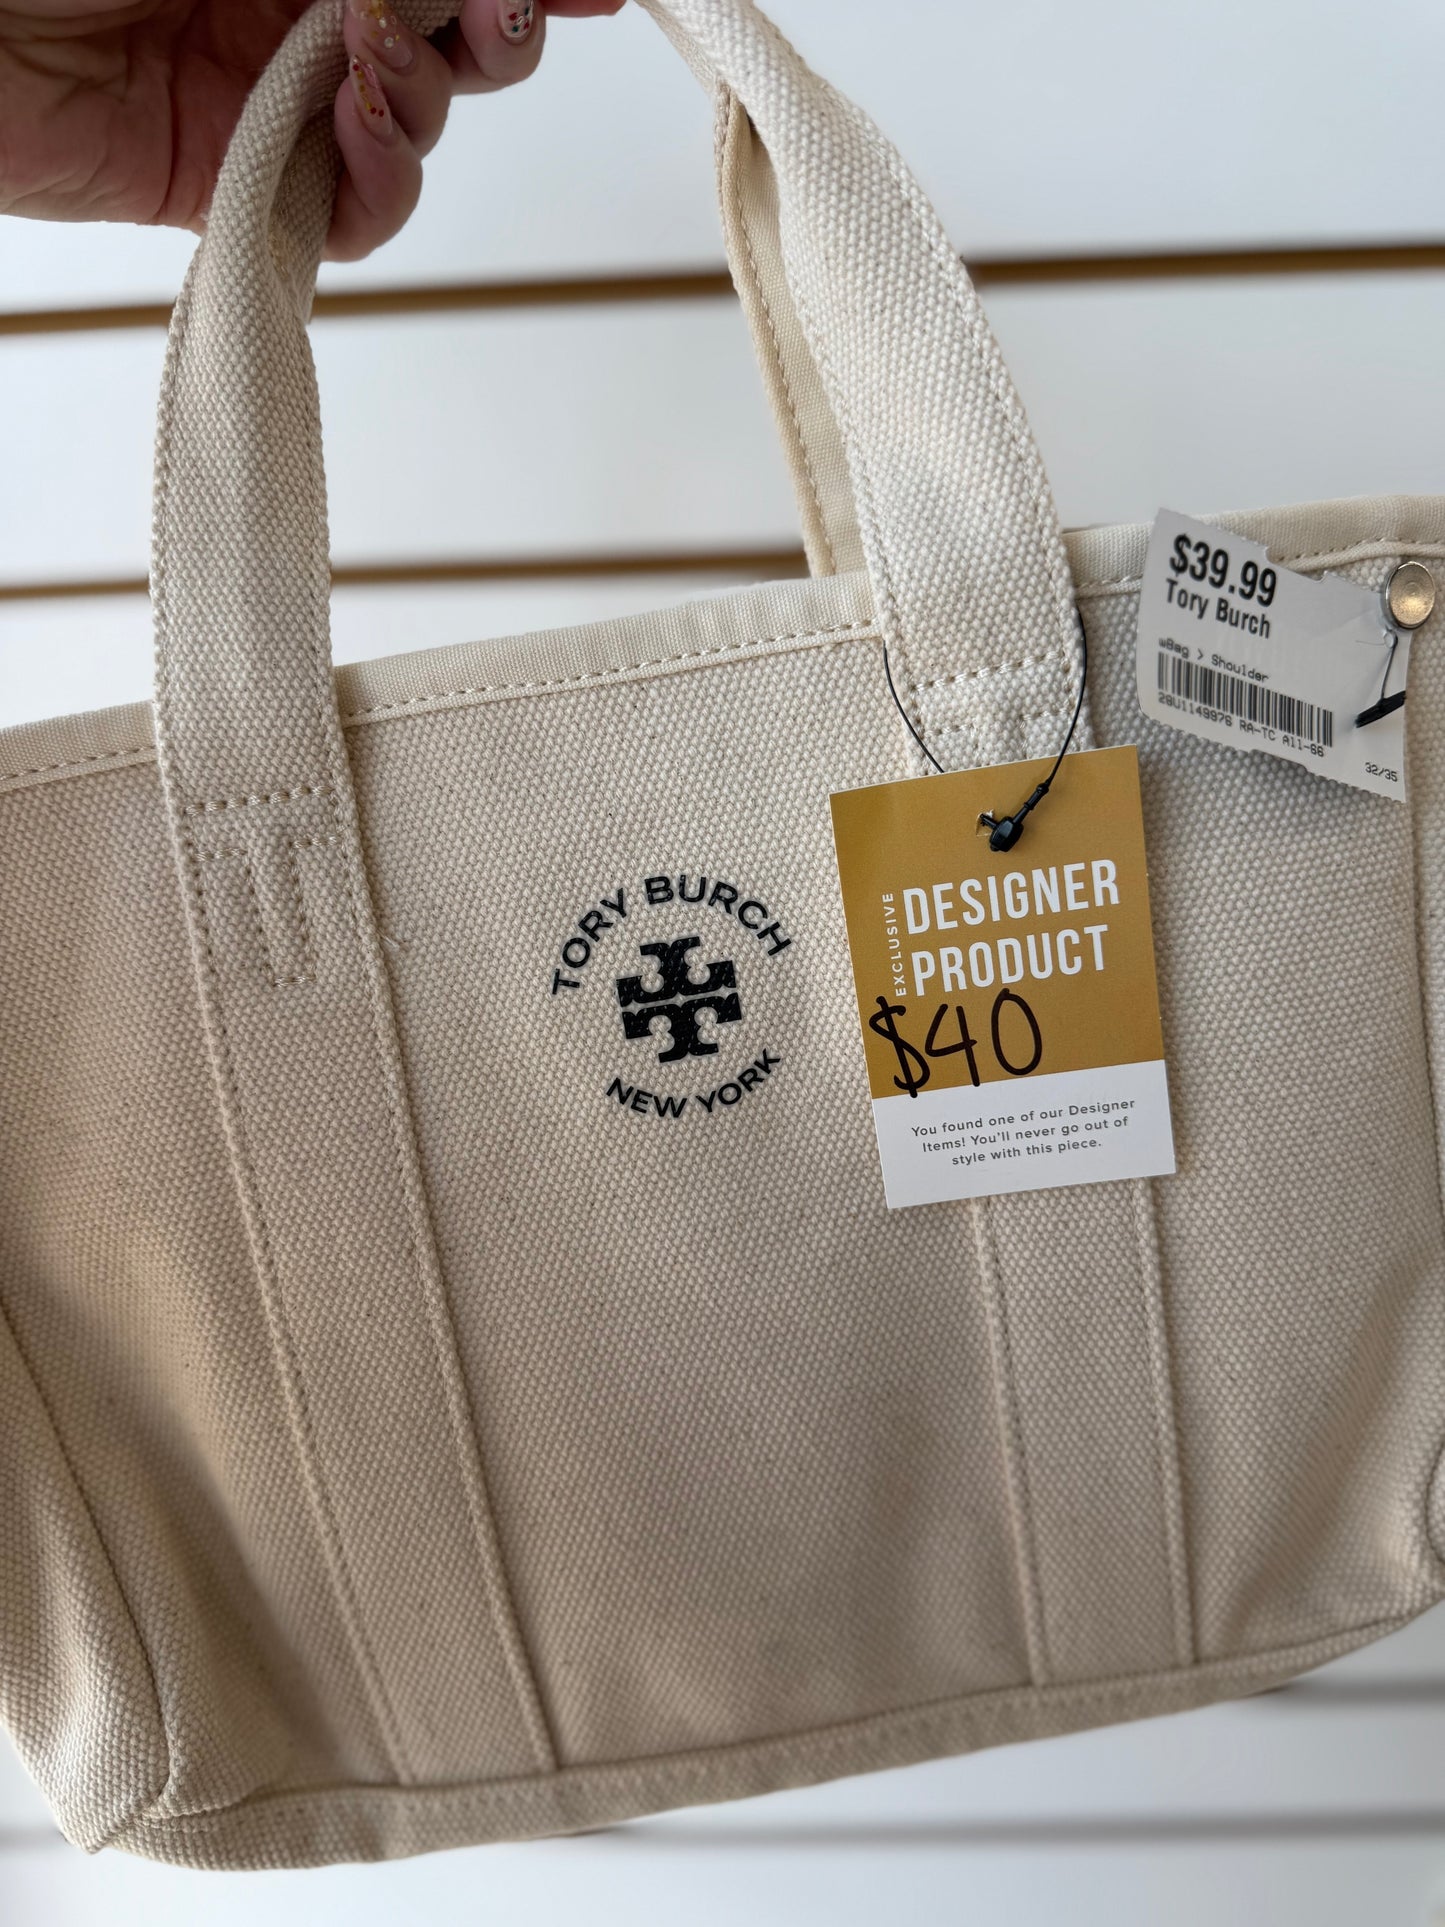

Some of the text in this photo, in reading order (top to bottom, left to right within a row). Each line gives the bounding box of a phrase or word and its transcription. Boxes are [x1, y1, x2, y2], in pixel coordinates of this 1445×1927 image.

[1169, 533, 1277, 607] $39.99
[1166, 578, 1270, 639] Tory Burch
[1158, 637, 1189, 659] wBag
[1211, 654, 1269, 683] Shoulder
[1240, 719, 1276, 741] RA-TC
[1365, 762, 1398, 782] 32/35
[903, 859, 1120, 934] DESIGNER
[552, 874, 792, 995] TORY BURCH
[882, 892, 907, 997] EXCLUSIVE
[911, 924, 1108, 997] PRODUCT
[869, 987, 1043, 1098] $40
[606, 1048, 781, 1118] NEW YORK
[911, 1100, 1135, 1137] You found one of our Designer
[923, 1116, 1129, 1153] Items! You'll never go out of
[952, 1138, 1102, 1166] style with this piece.
